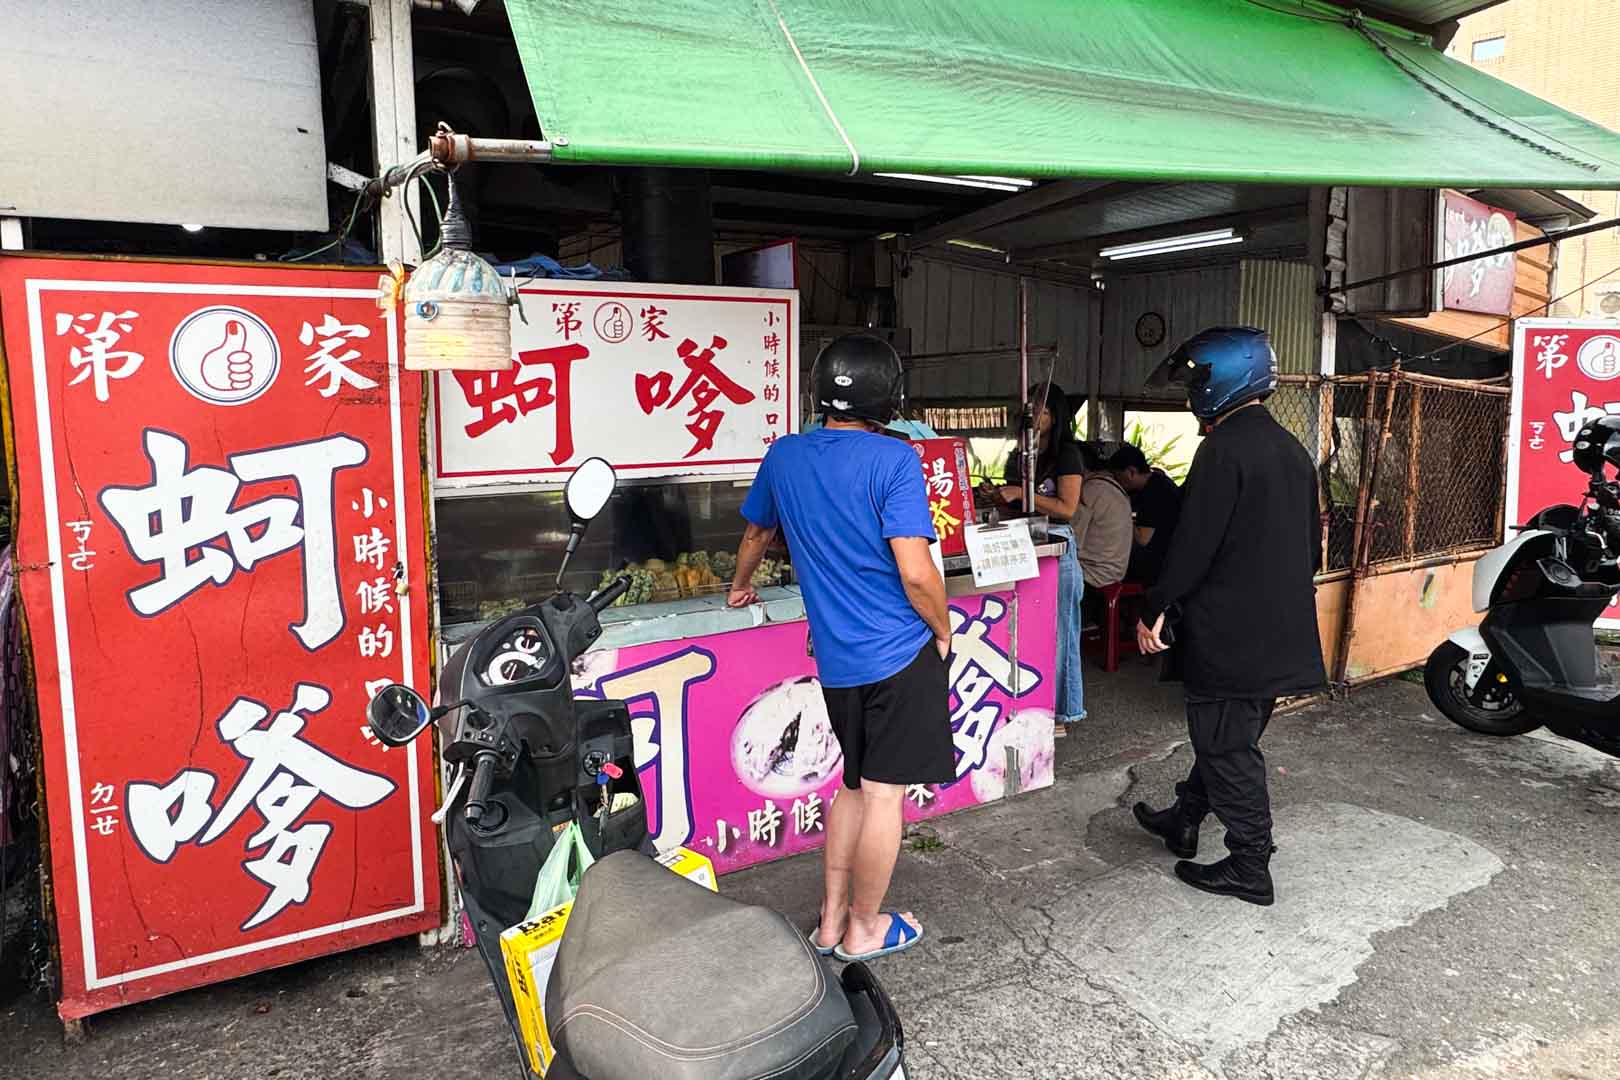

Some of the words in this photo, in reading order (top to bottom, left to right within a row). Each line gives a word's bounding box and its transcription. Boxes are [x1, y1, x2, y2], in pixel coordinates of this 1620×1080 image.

[552, 303, 583, 341] 第
[640, 305, 671, 342] 家
[56, 311, 145, 402] 第
[298, 314, 379, 397] 家
[1532, 334, 1569, 379] 第
[517, 907, 566, 933] Bar
